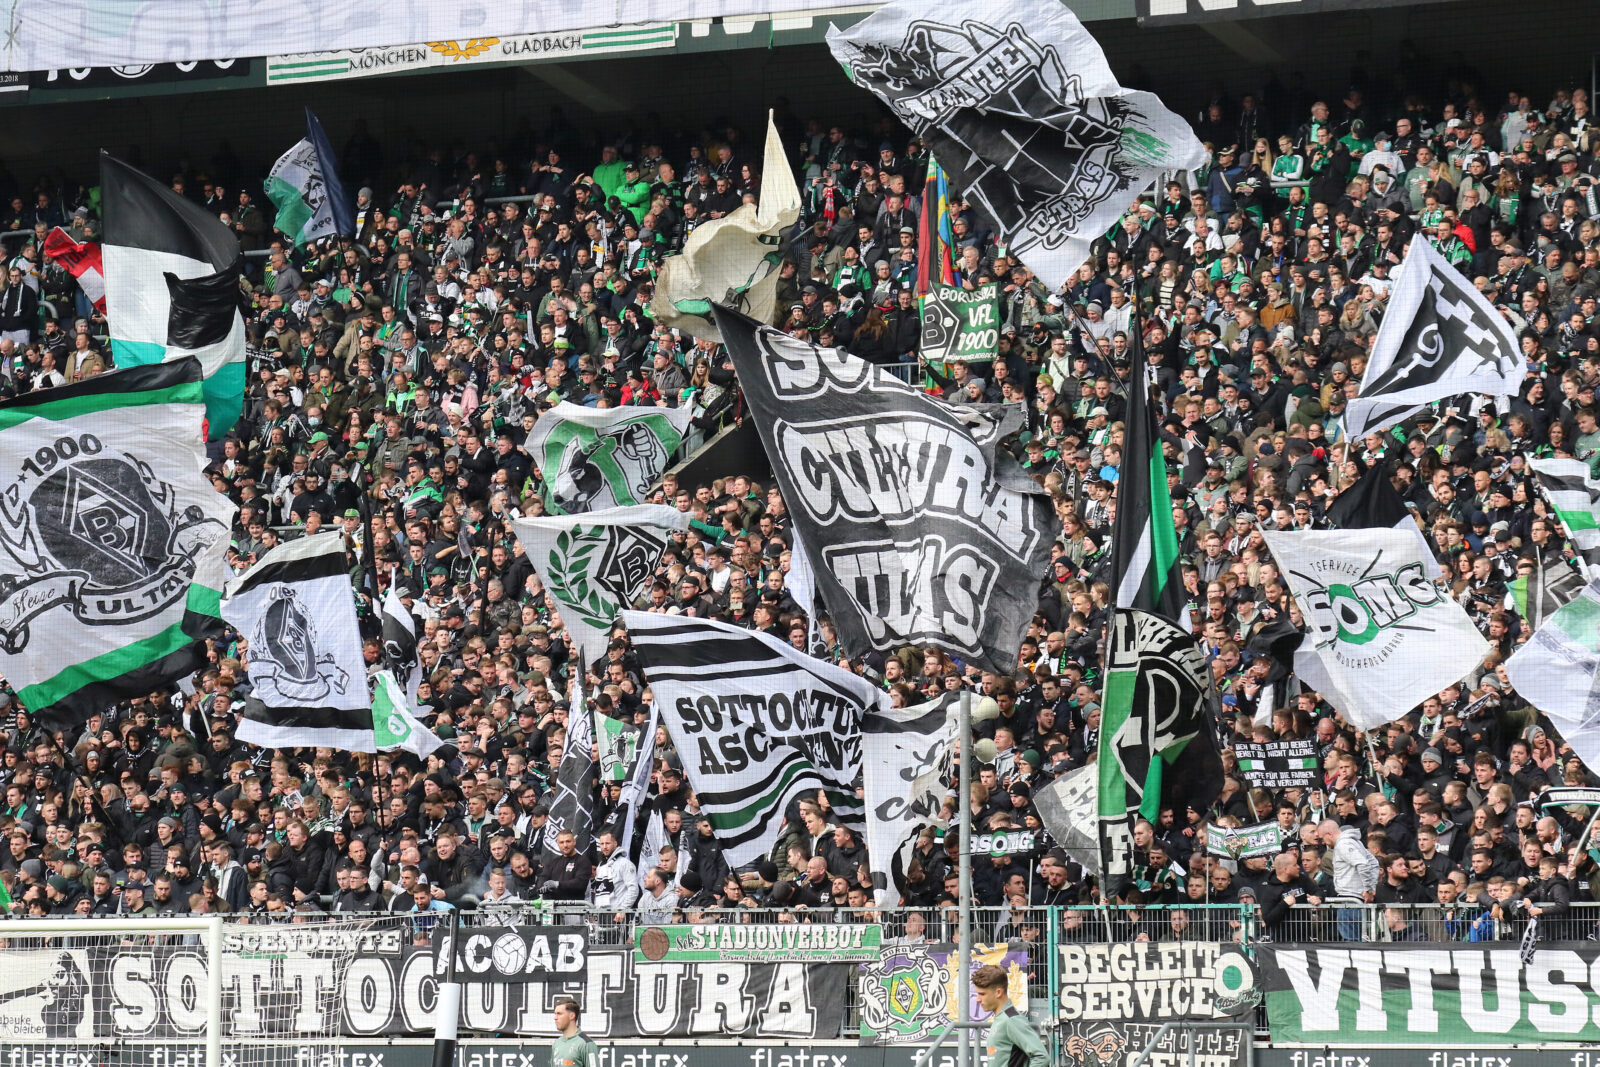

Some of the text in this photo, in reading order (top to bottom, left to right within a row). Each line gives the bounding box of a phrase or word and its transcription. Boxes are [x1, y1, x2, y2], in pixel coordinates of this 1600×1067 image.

[349, 47, 427, 71] MÖNCHEN
[502, 35, 582, 56] GLADBACH
[940, 285, 997, 303] BORUSSIA
[968, 303, 995, 328] VFL
[957, 328, 998, 352] 1900
[21, 433, 103, 478] 1900
[1268, 749, 1287, 757] NICHT
[691, 925, 868, 949] STADIONVERBOT
[1060, 942, 1220, 983] BEGLEIT
[1060, 979, 1215, 1020] SERVICE
[1275, 949, 1600, 1034] VITUS
[149, 1046, 238, 1067] flatx
